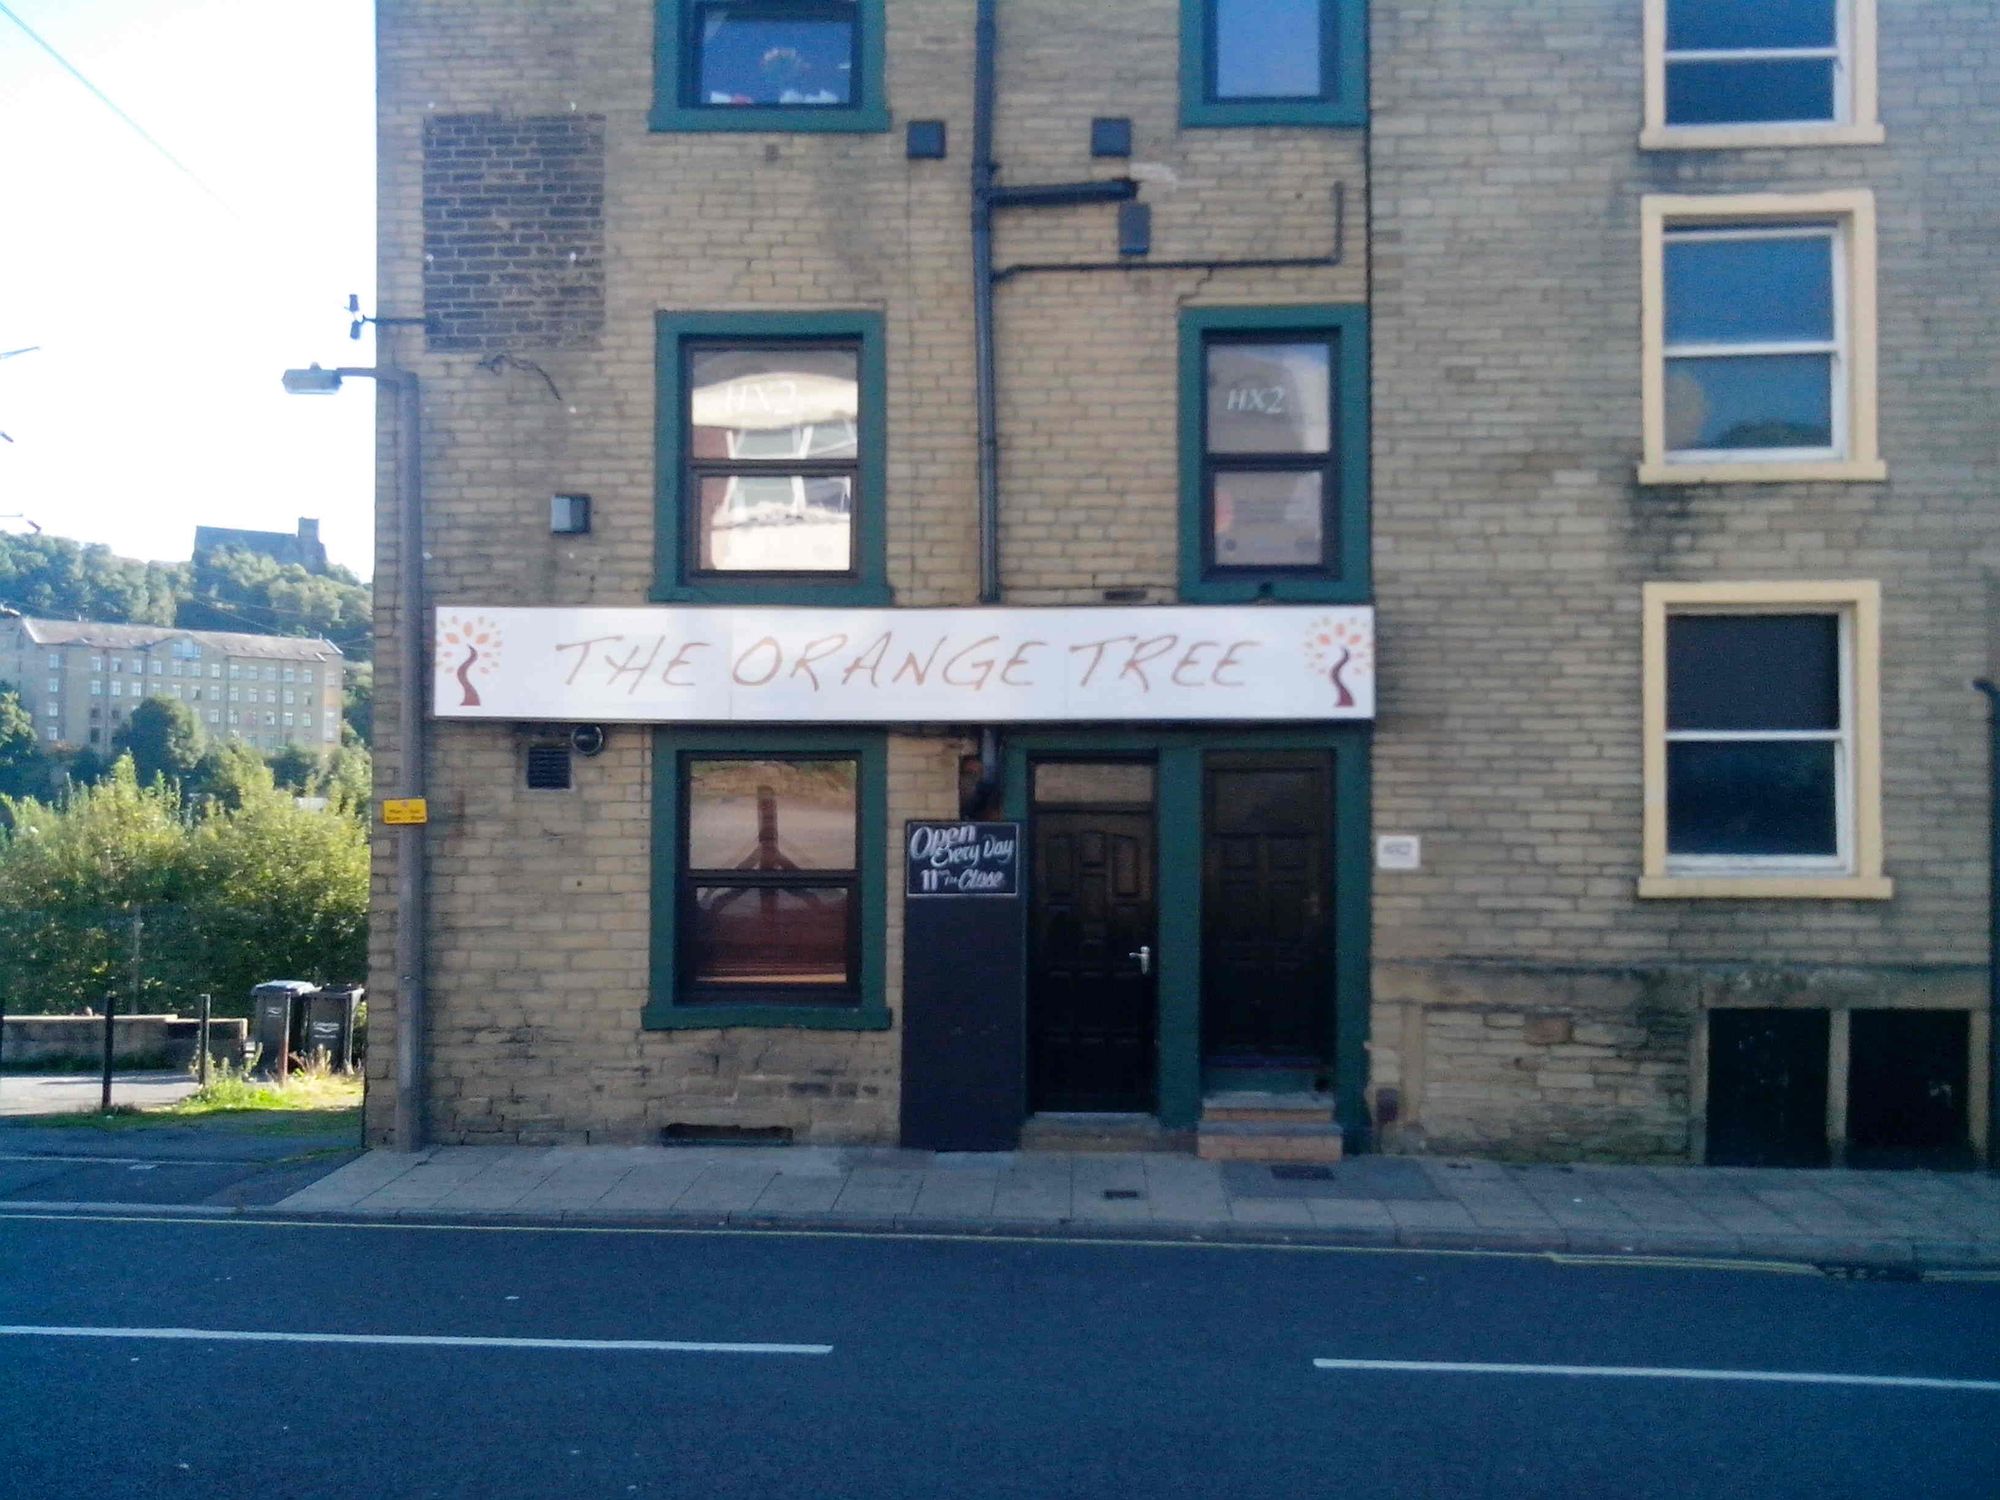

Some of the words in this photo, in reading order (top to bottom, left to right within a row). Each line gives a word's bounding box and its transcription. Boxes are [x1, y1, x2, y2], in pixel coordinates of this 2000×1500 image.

[1227, 386, 1285, 414] HX2
[555, 635, 710, 695] THE
[732, 631, 1047, 692] ORANGE
[1070, 634, 1261, 692] TREE
[910, 825, 976, 859] Open
[931, 844, 981, 867] Every
[982, 834, 1014, 864] Day
[958, 868, 1005, 890] Close
